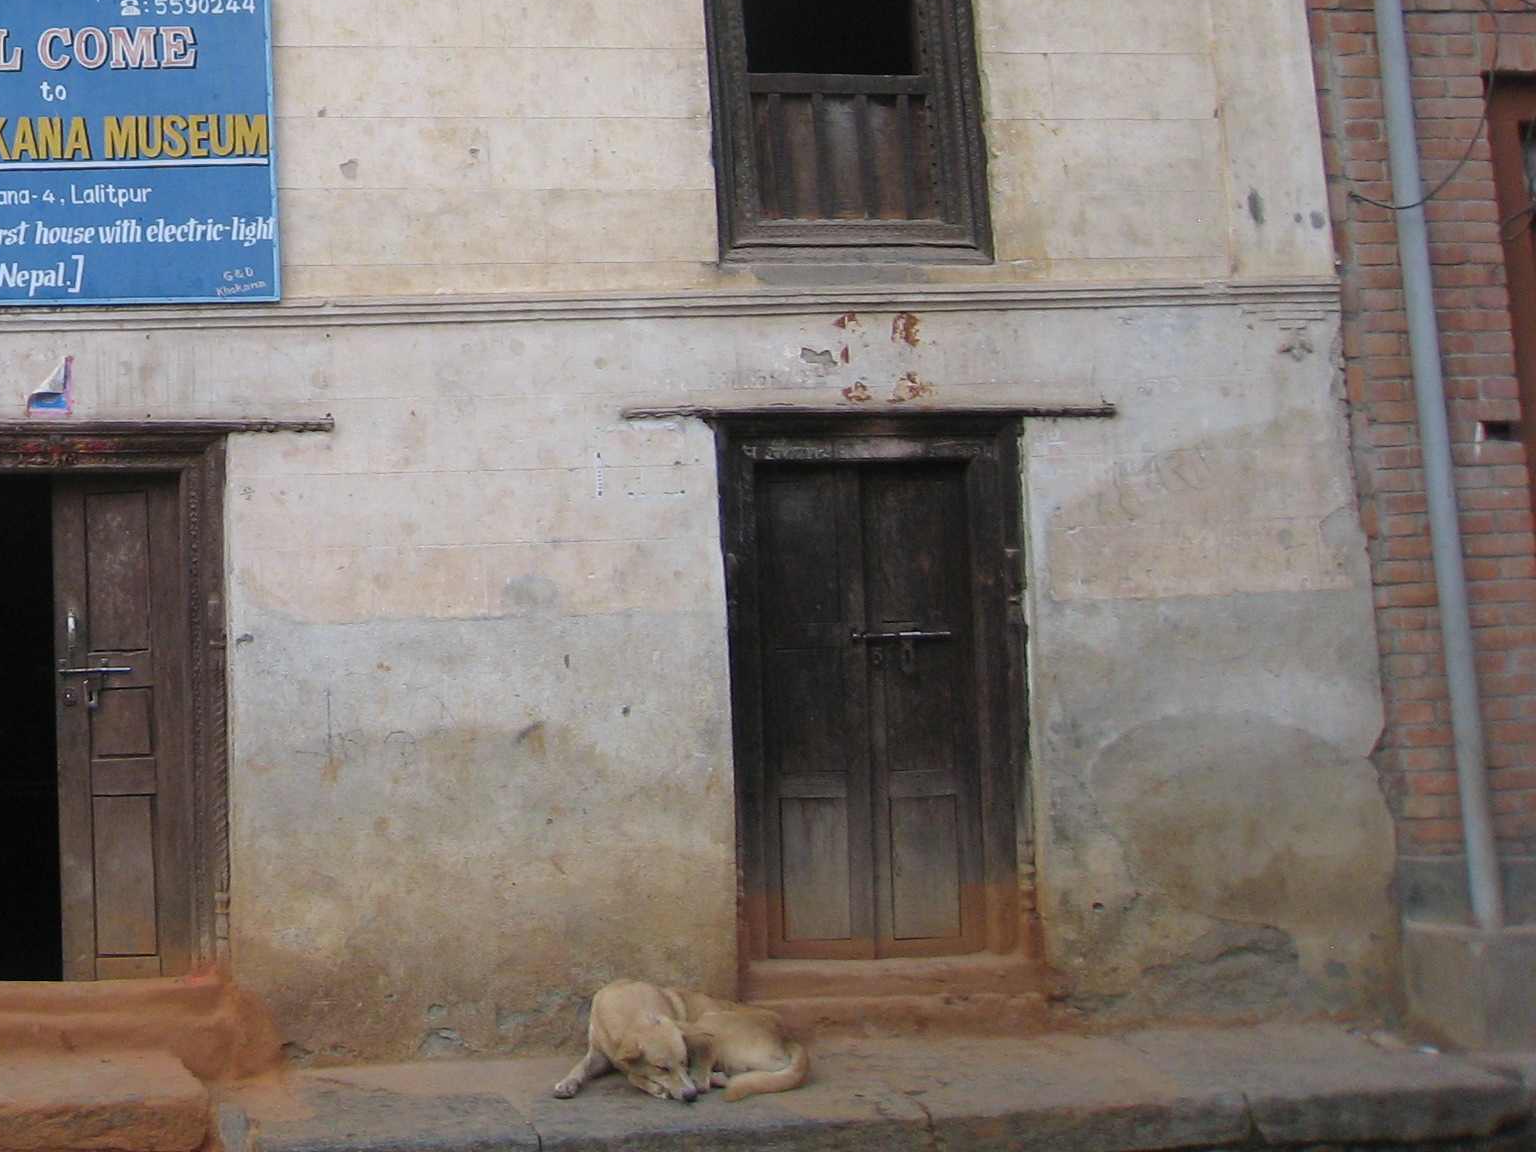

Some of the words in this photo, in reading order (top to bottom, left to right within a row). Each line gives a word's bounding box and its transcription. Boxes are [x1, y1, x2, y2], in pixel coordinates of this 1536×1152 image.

[37, 25, 199, 70] COME
[40, 81, 67, 102] to
[104, 114, 269, 160] MUSEUM
[71, 184, 153, 208] Lalitpur
[35, 220, 95, 245] house
[98, 218, 142, 244] with
[146, 215, 277, 247] electric-light
